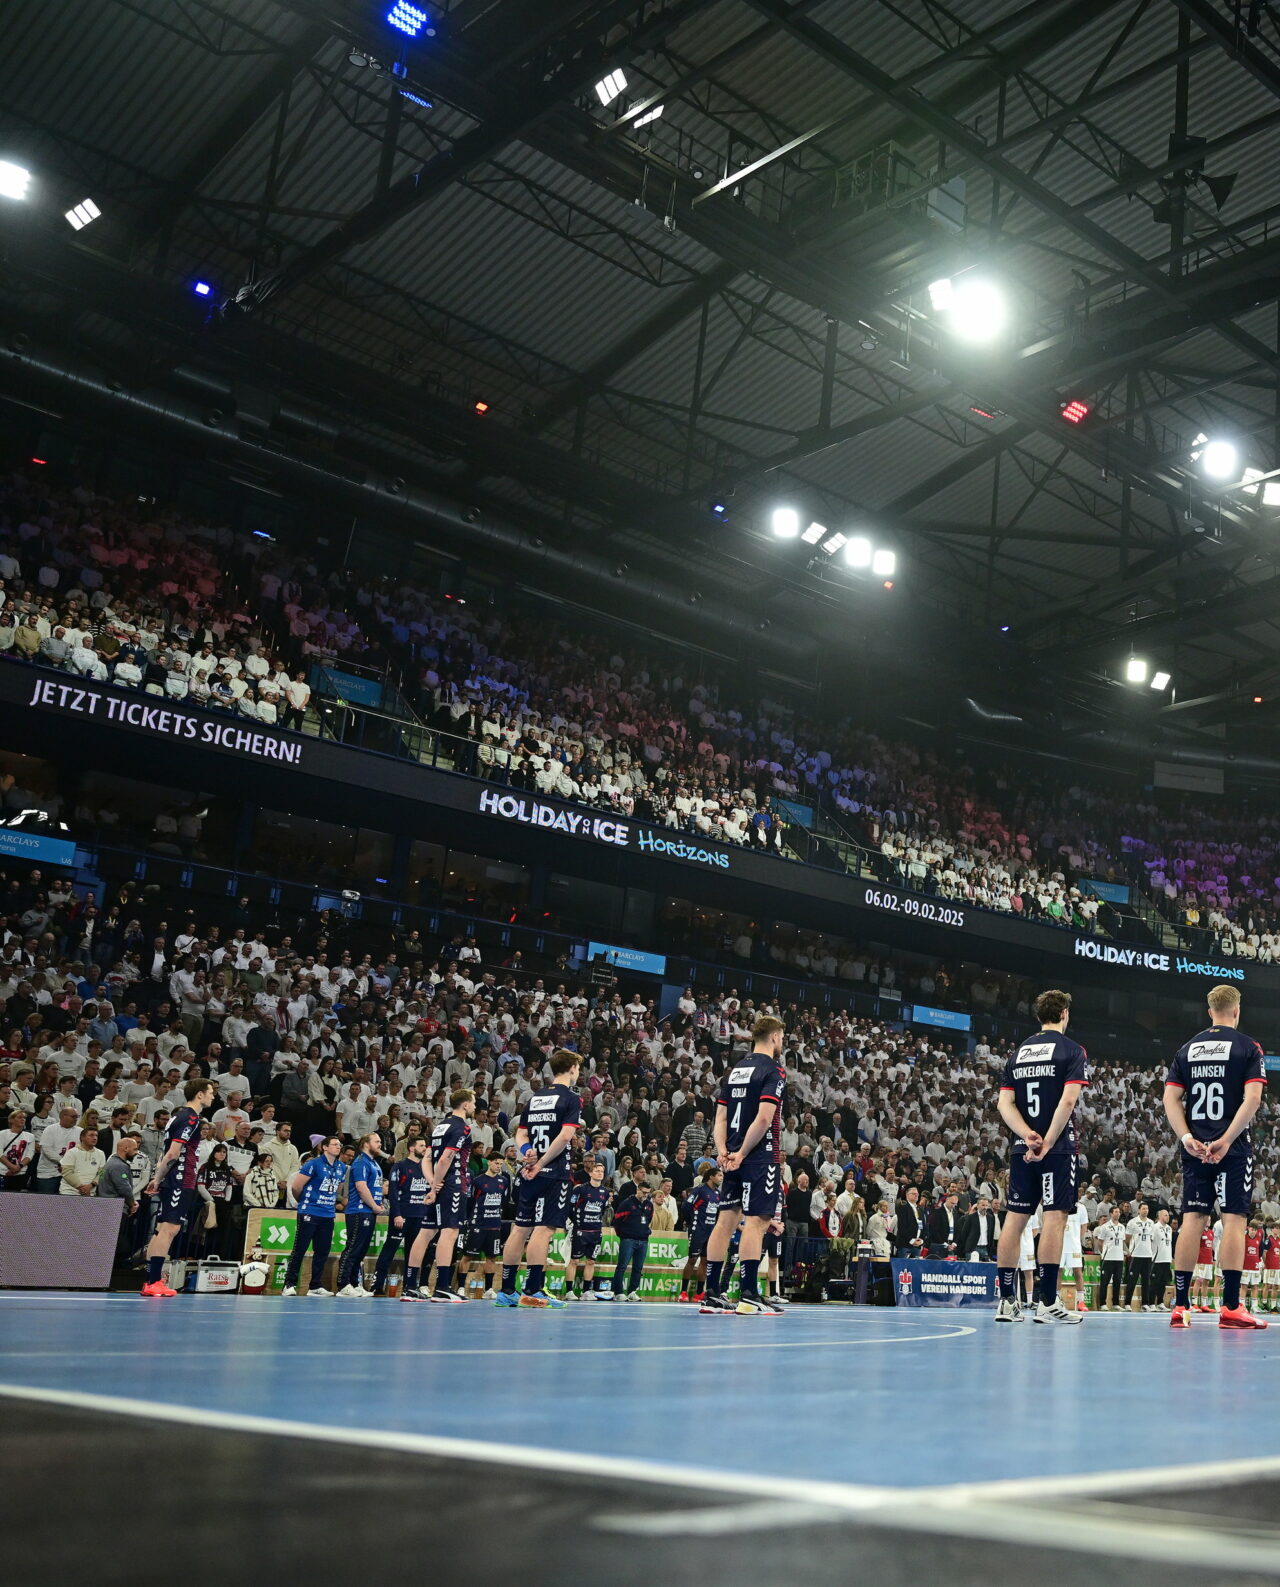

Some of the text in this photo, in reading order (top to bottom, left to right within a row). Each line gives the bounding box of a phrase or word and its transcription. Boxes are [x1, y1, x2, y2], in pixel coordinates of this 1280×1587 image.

[30, 679, 302, 764] JETZT TICKETS SICHERN!
[479, 789, 583, 834] HOLIDAY
[593, 820, 629, 846] ICE
[0, 834, 40, 848] ARCLAYS
[0, 844, 16, 853] rena
[865, 889, 964, 927] 06.02.-09.02.2025
[1075, 937, 1137, 966] HOLIDAY
[1144, 952, 1170, 972] ICE
[1191, 1065, 1226, 1078] HANSEN
[1026, 1082, 1040, 1118] 5
[1191, 1082, 1224, 1121] 26
[730, 1102, 742, 1133] 4
[531, 1125, 550, 1153] 25
[921, 1273, 987, 1284] HANDBALL SPORT
[921, 1284, 987, 1295] VEREIN HAMBURG
